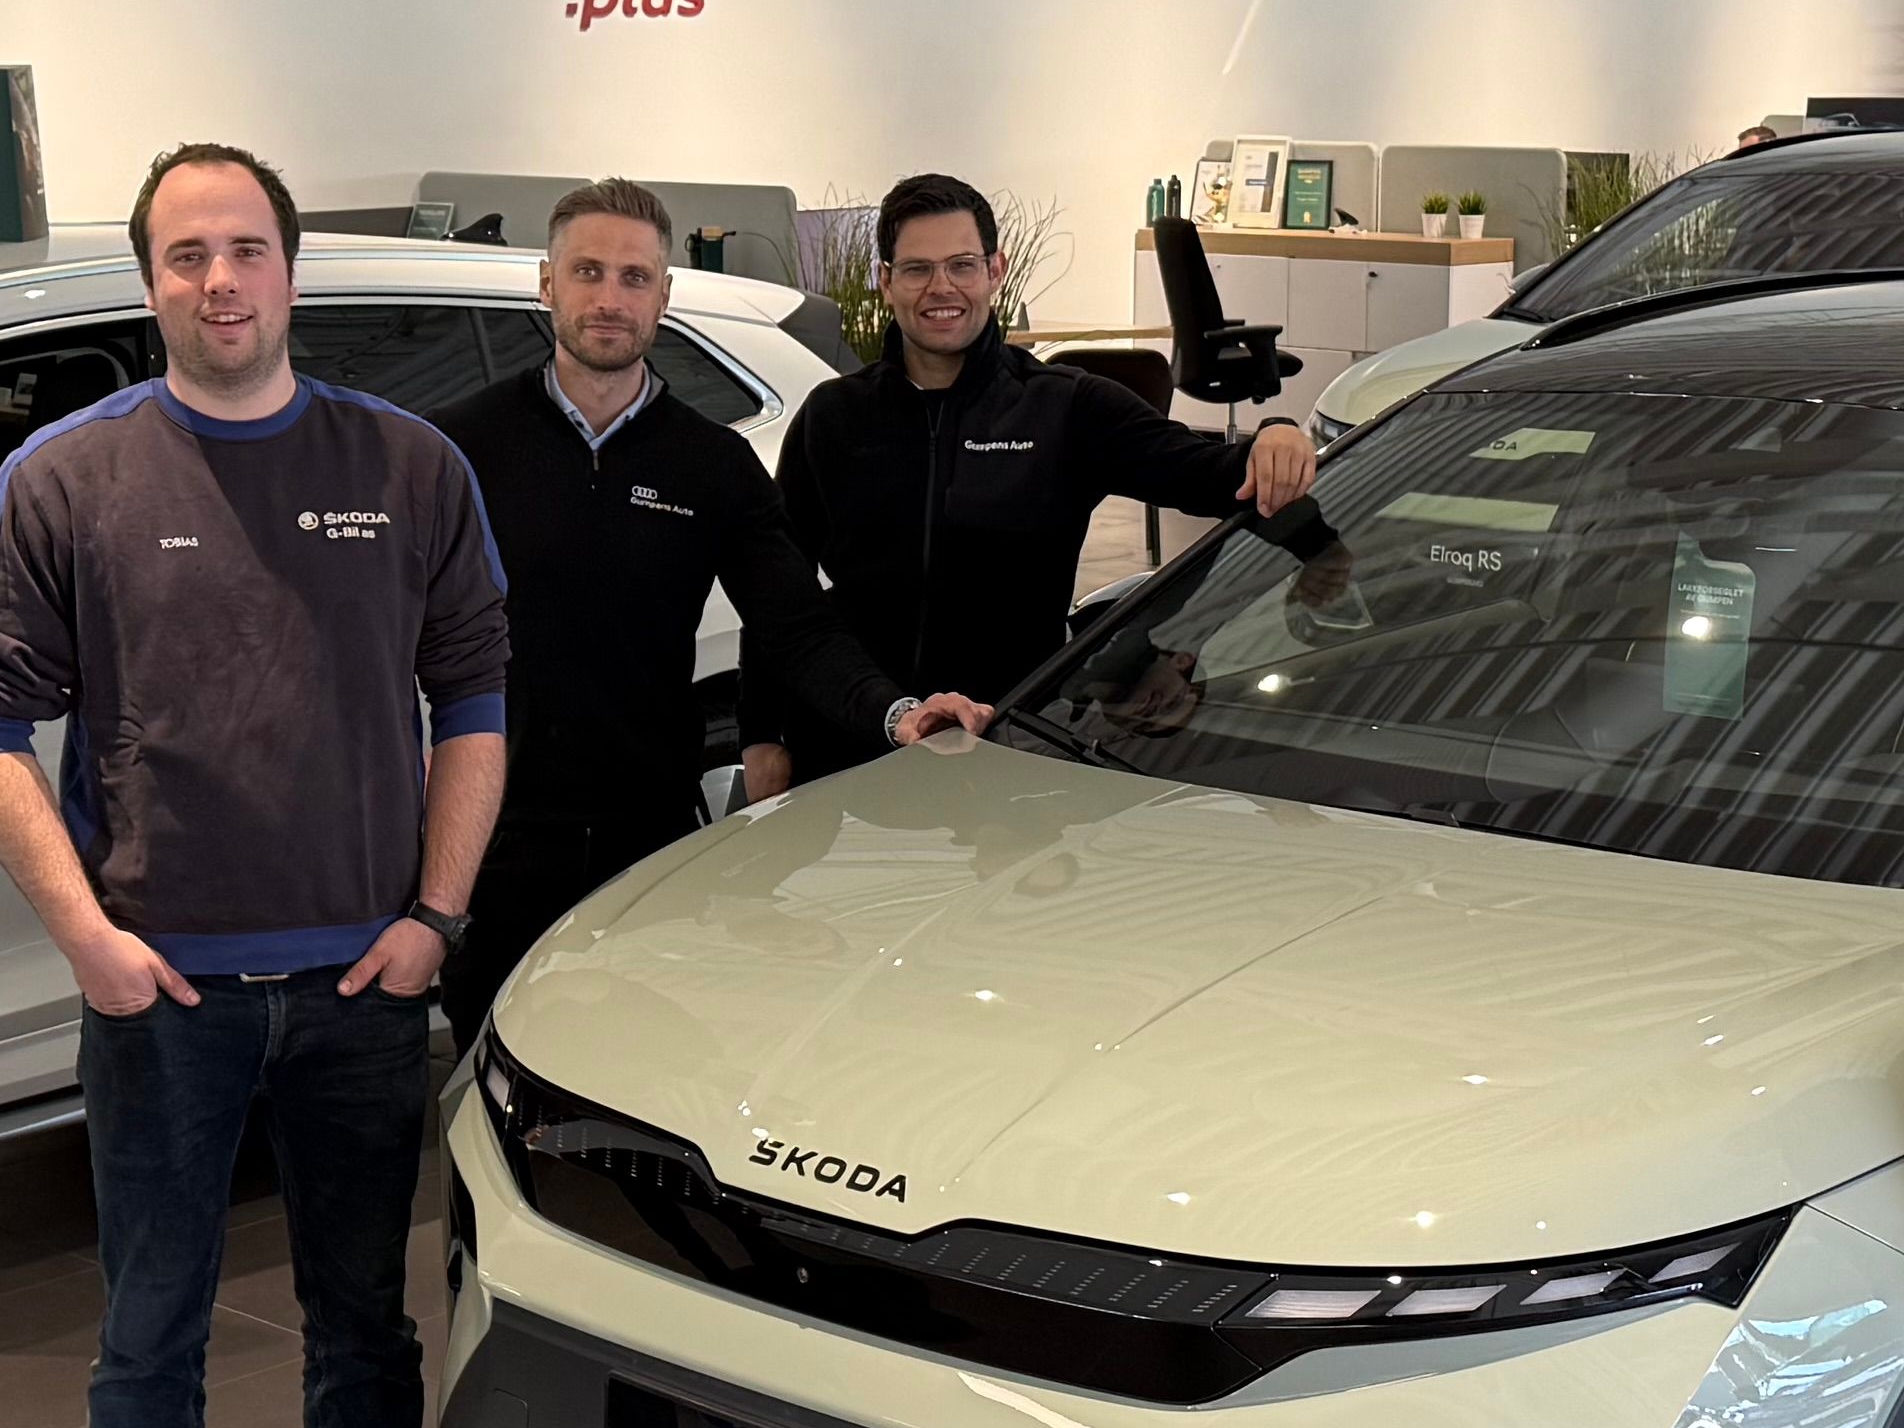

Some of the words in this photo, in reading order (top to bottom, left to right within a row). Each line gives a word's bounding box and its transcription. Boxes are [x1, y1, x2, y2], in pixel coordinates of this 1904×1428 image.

[160, 536, 199, 549] TOBIAS
[1430, 545, 1473, 572] Elroq
[1477, 550, 1502, 571] RS
